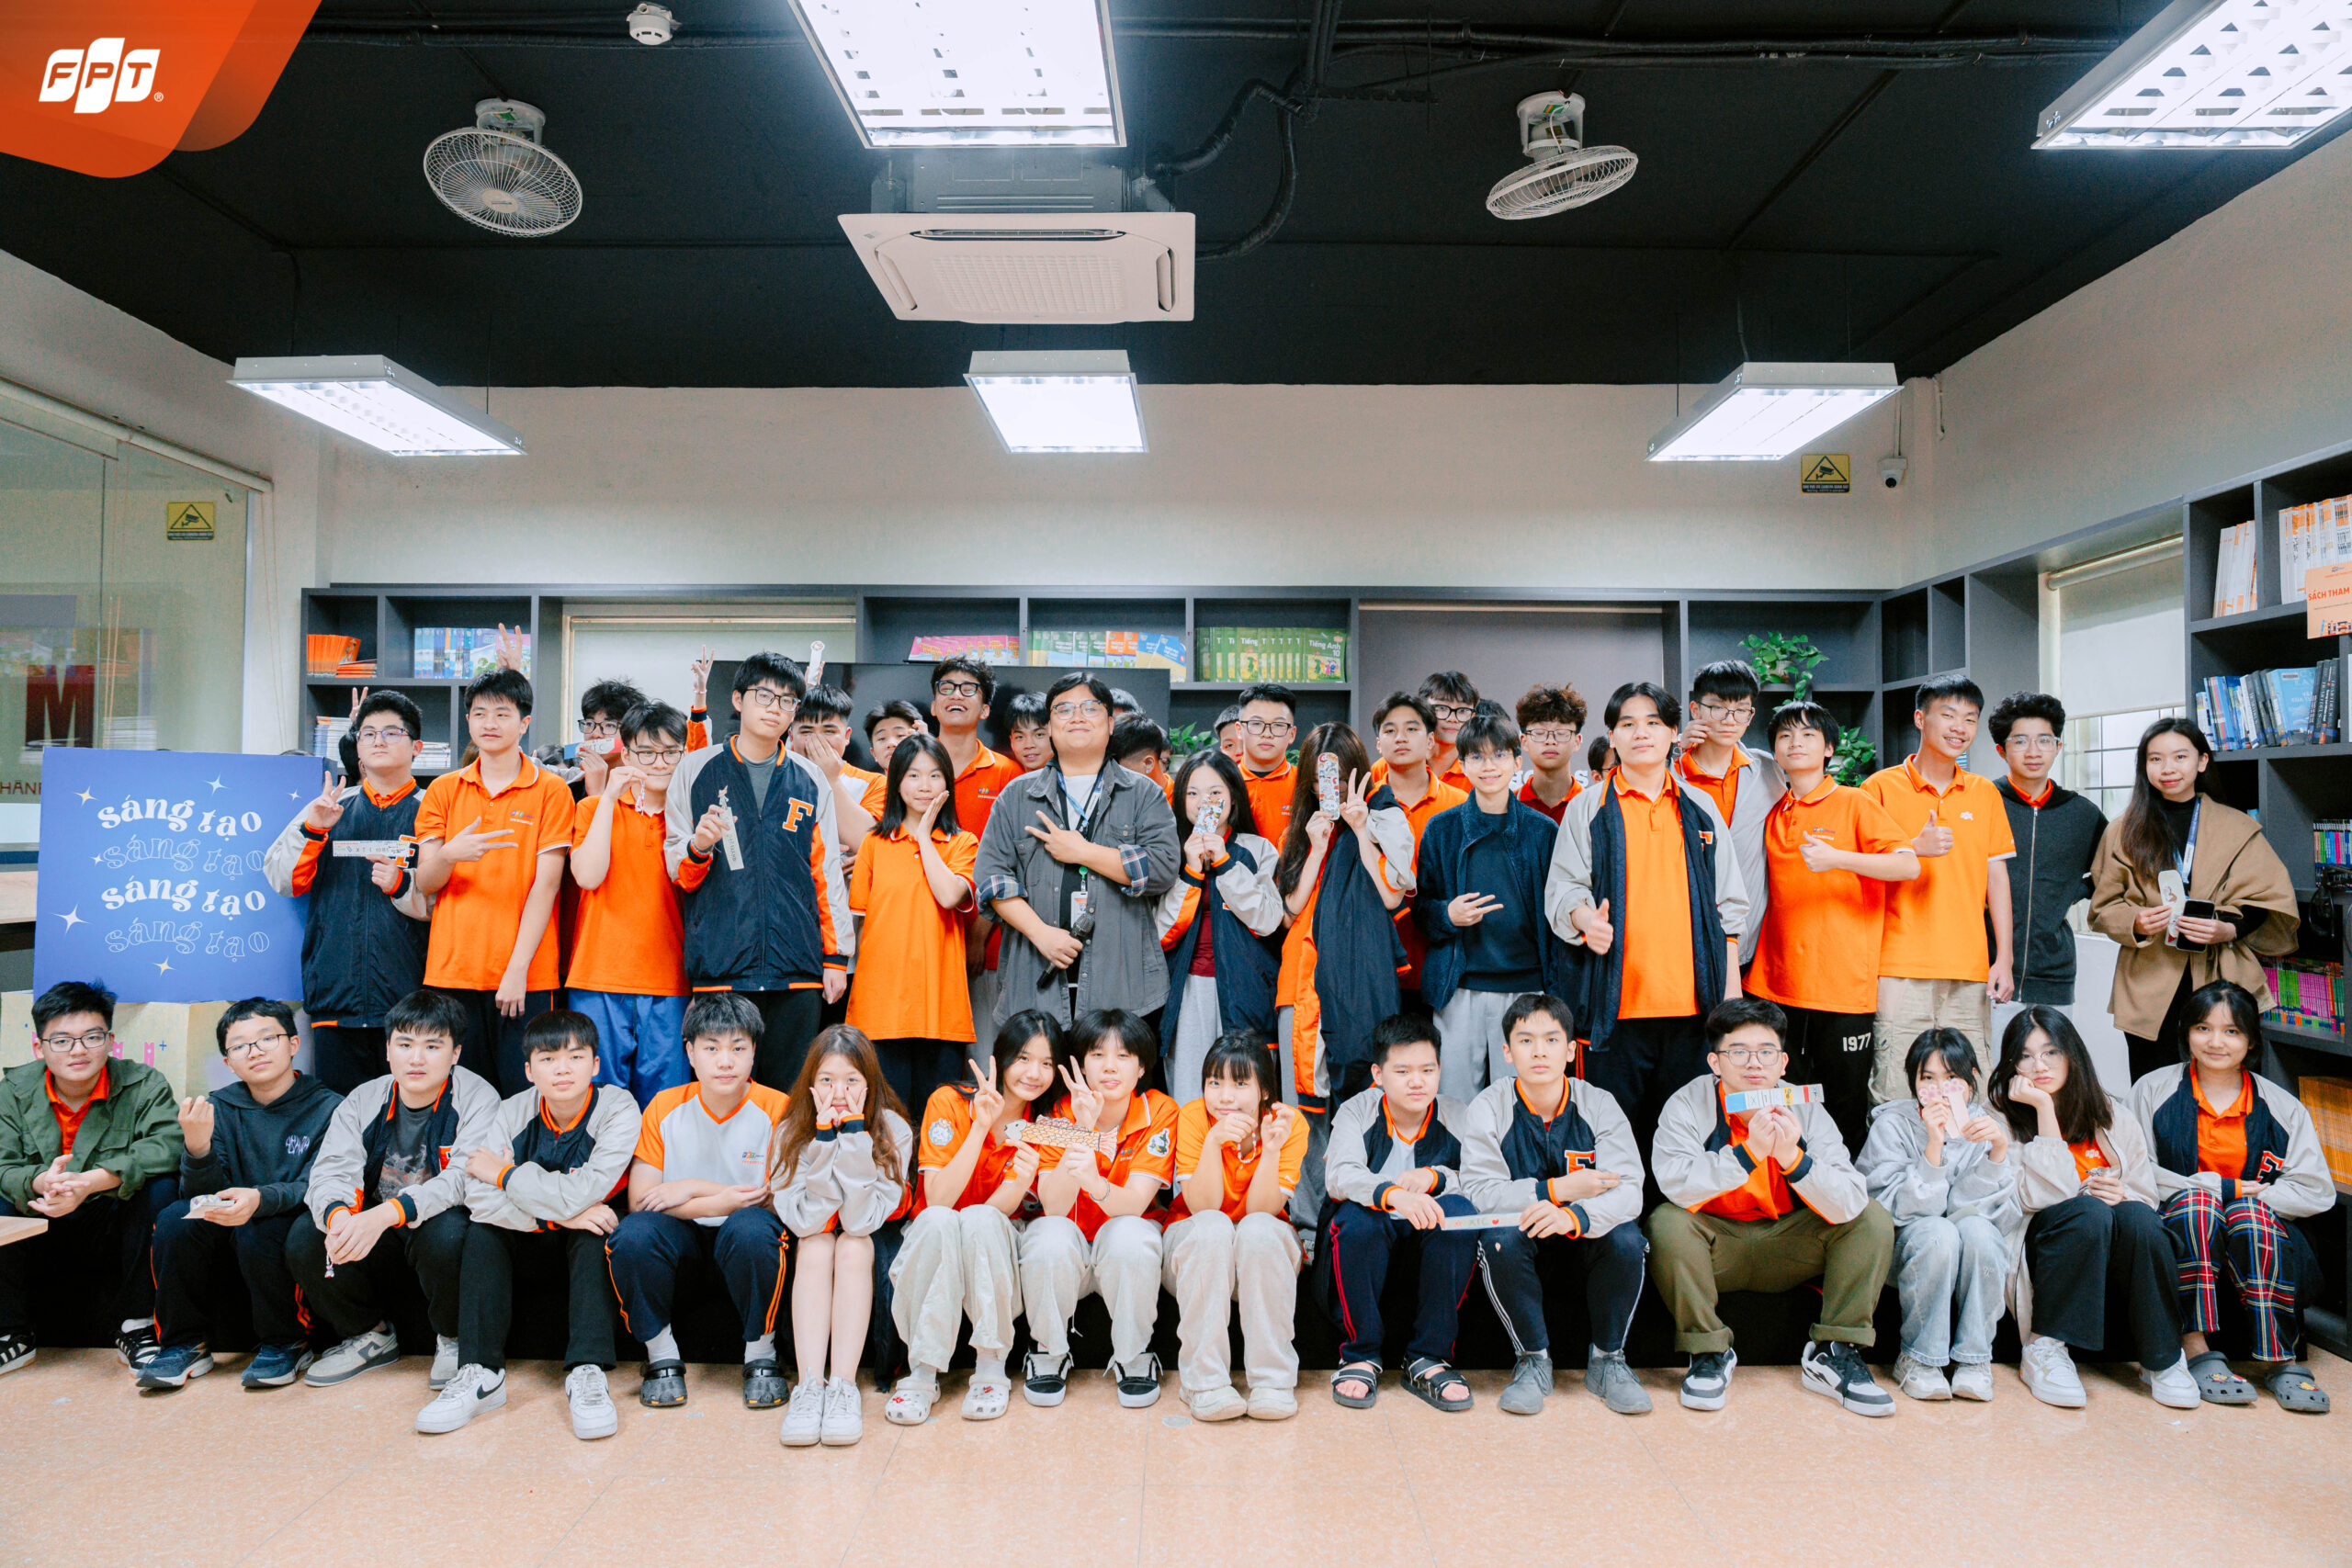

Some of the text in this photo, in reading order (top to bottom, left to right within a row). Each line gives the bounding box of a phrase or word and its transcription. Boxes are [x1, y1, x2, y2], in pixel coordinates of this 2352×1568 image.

[2308, 586, 2350, 602] SÁCH THAM
[1308, 639, 1326, 649] Tiếng
[1327, 642, 1341, 650] Anh
[1332, 649, 1340, 658] 10
[97, 794, 263, 841] sáng tạo
[782, 796, 815, 832] F
[102, 834, 266, 881] sáng tạo
[101, 875, 266, 921] sáng tạo
[105, 918, 270, 963] sáng tạo
[1842, 1032, 1871, 1052] 1977
[2255, 1150, 2285, 1182] F
